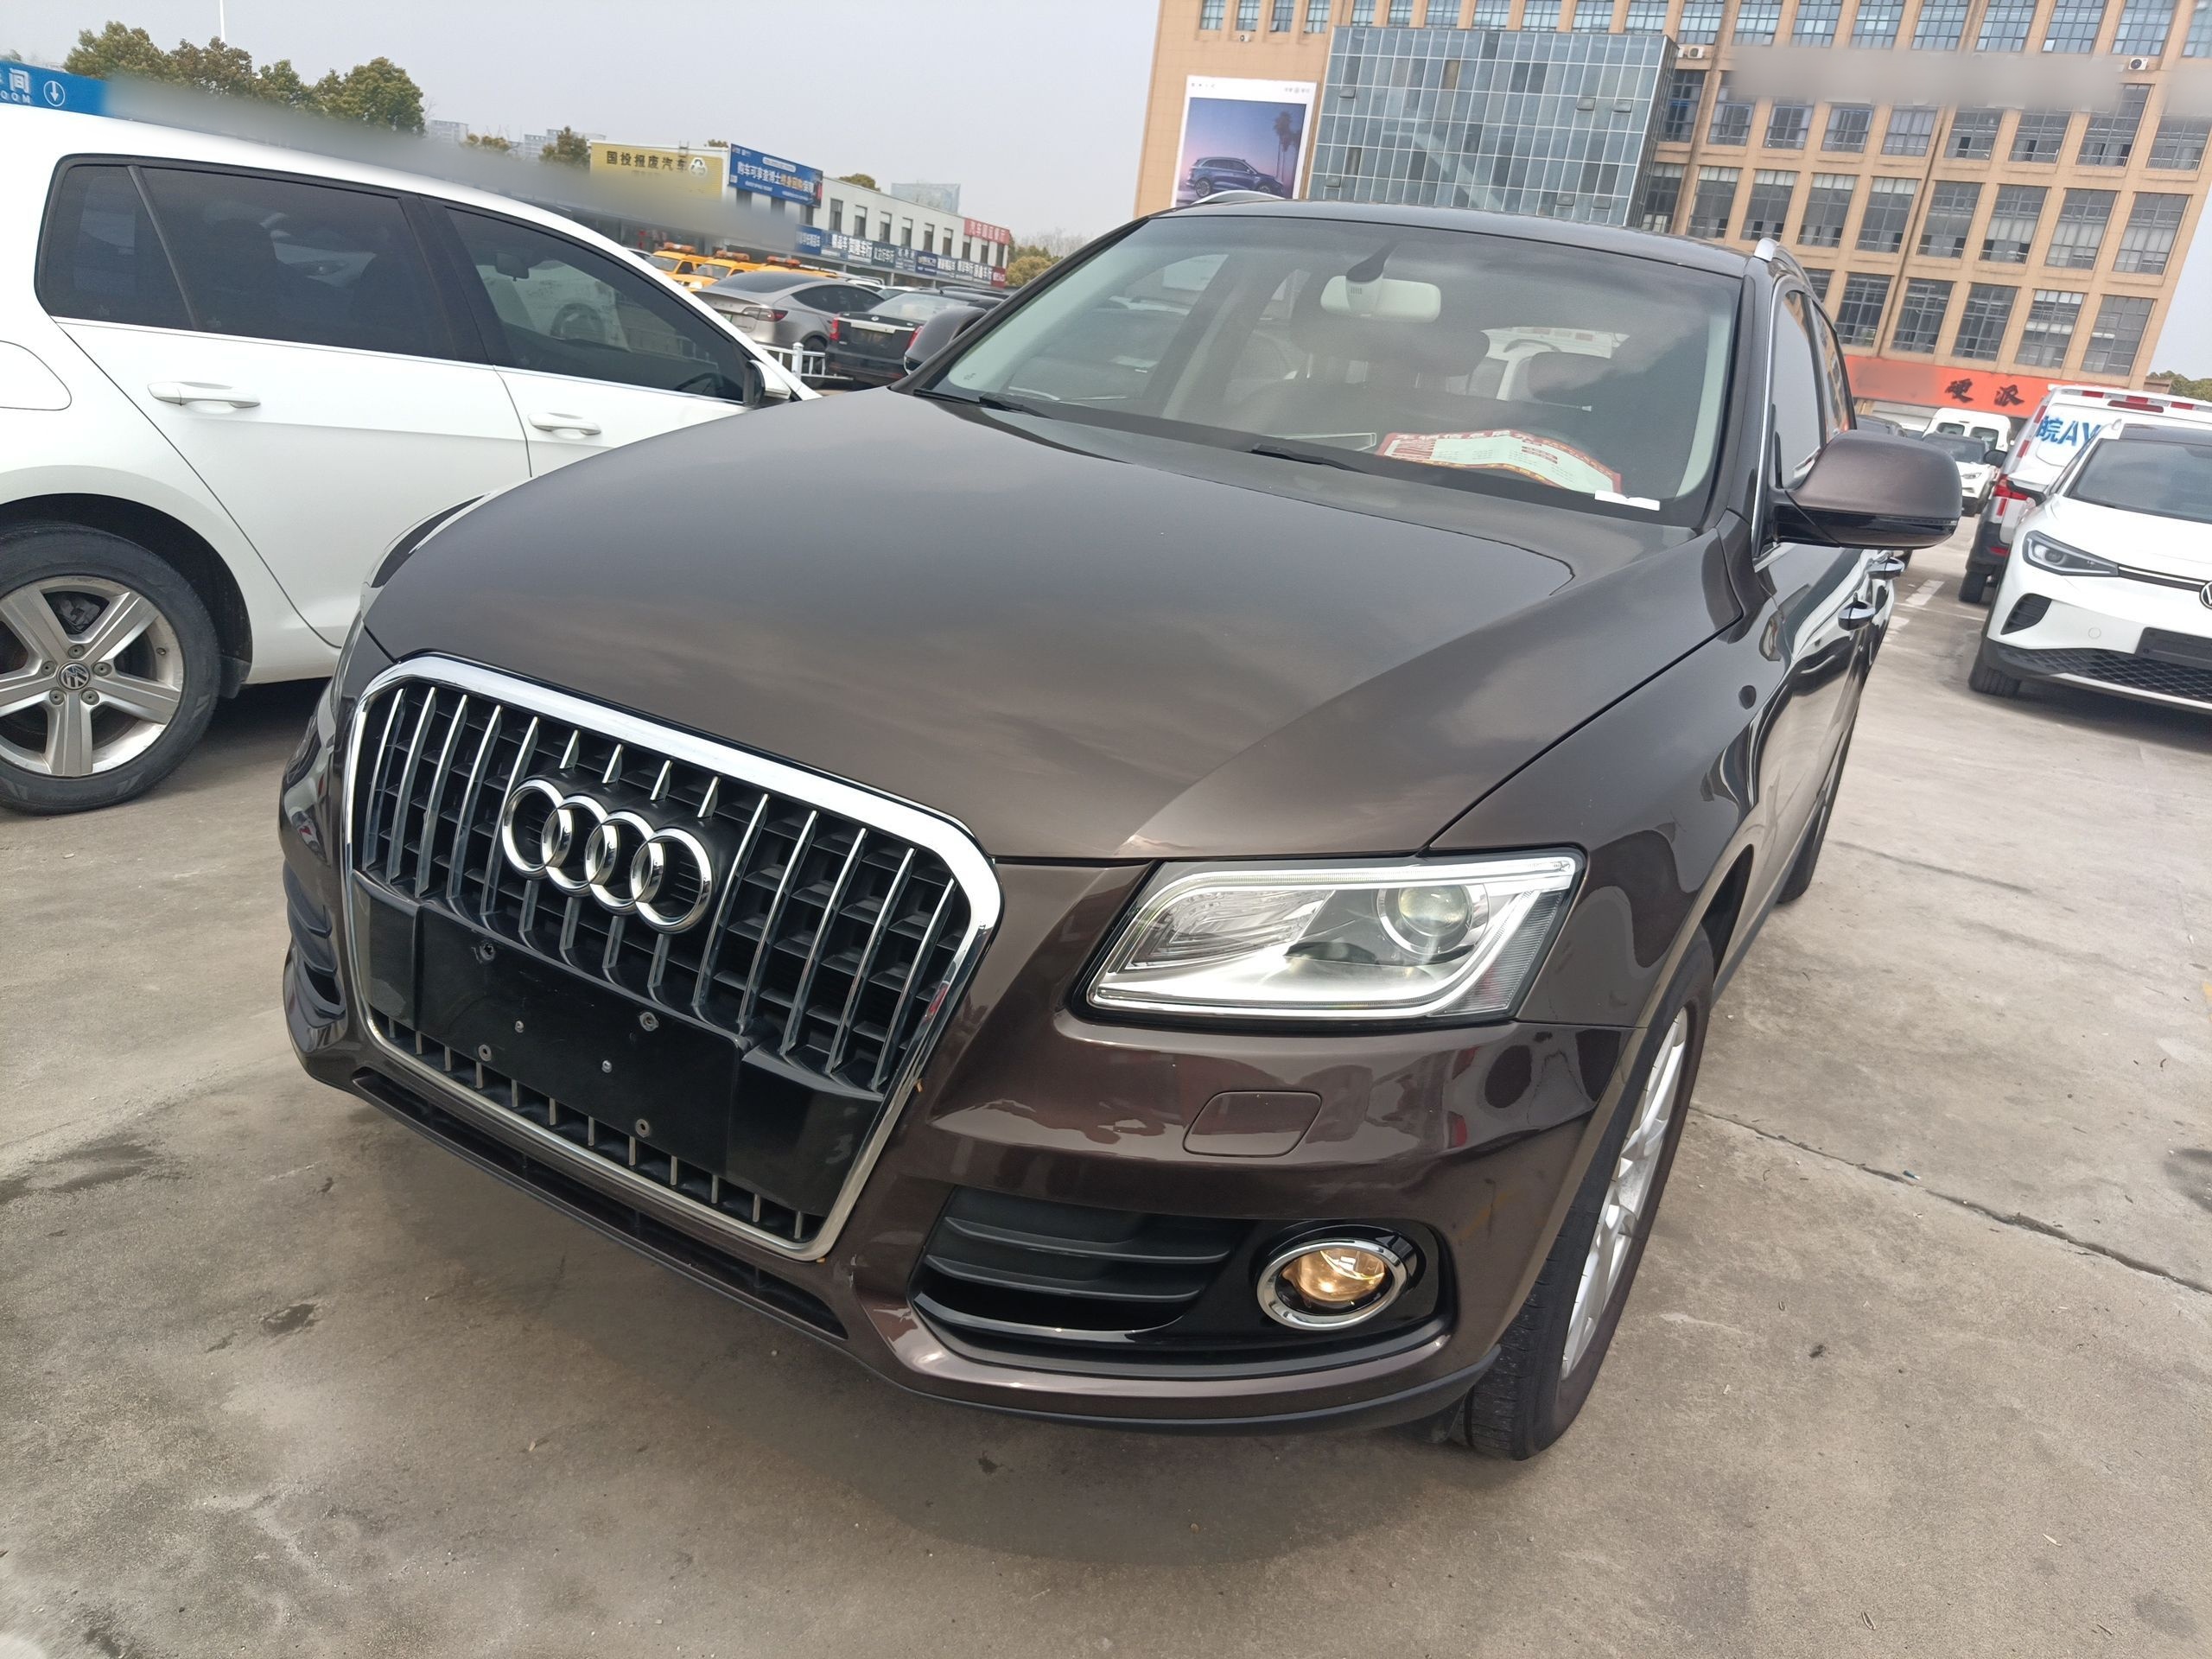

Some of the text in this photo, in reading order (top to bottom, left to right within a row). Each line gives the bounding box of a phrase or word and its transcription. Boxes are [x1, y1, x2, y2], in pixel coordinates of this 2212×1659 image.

[607, 150, 688, 172] 国投报废汽车
